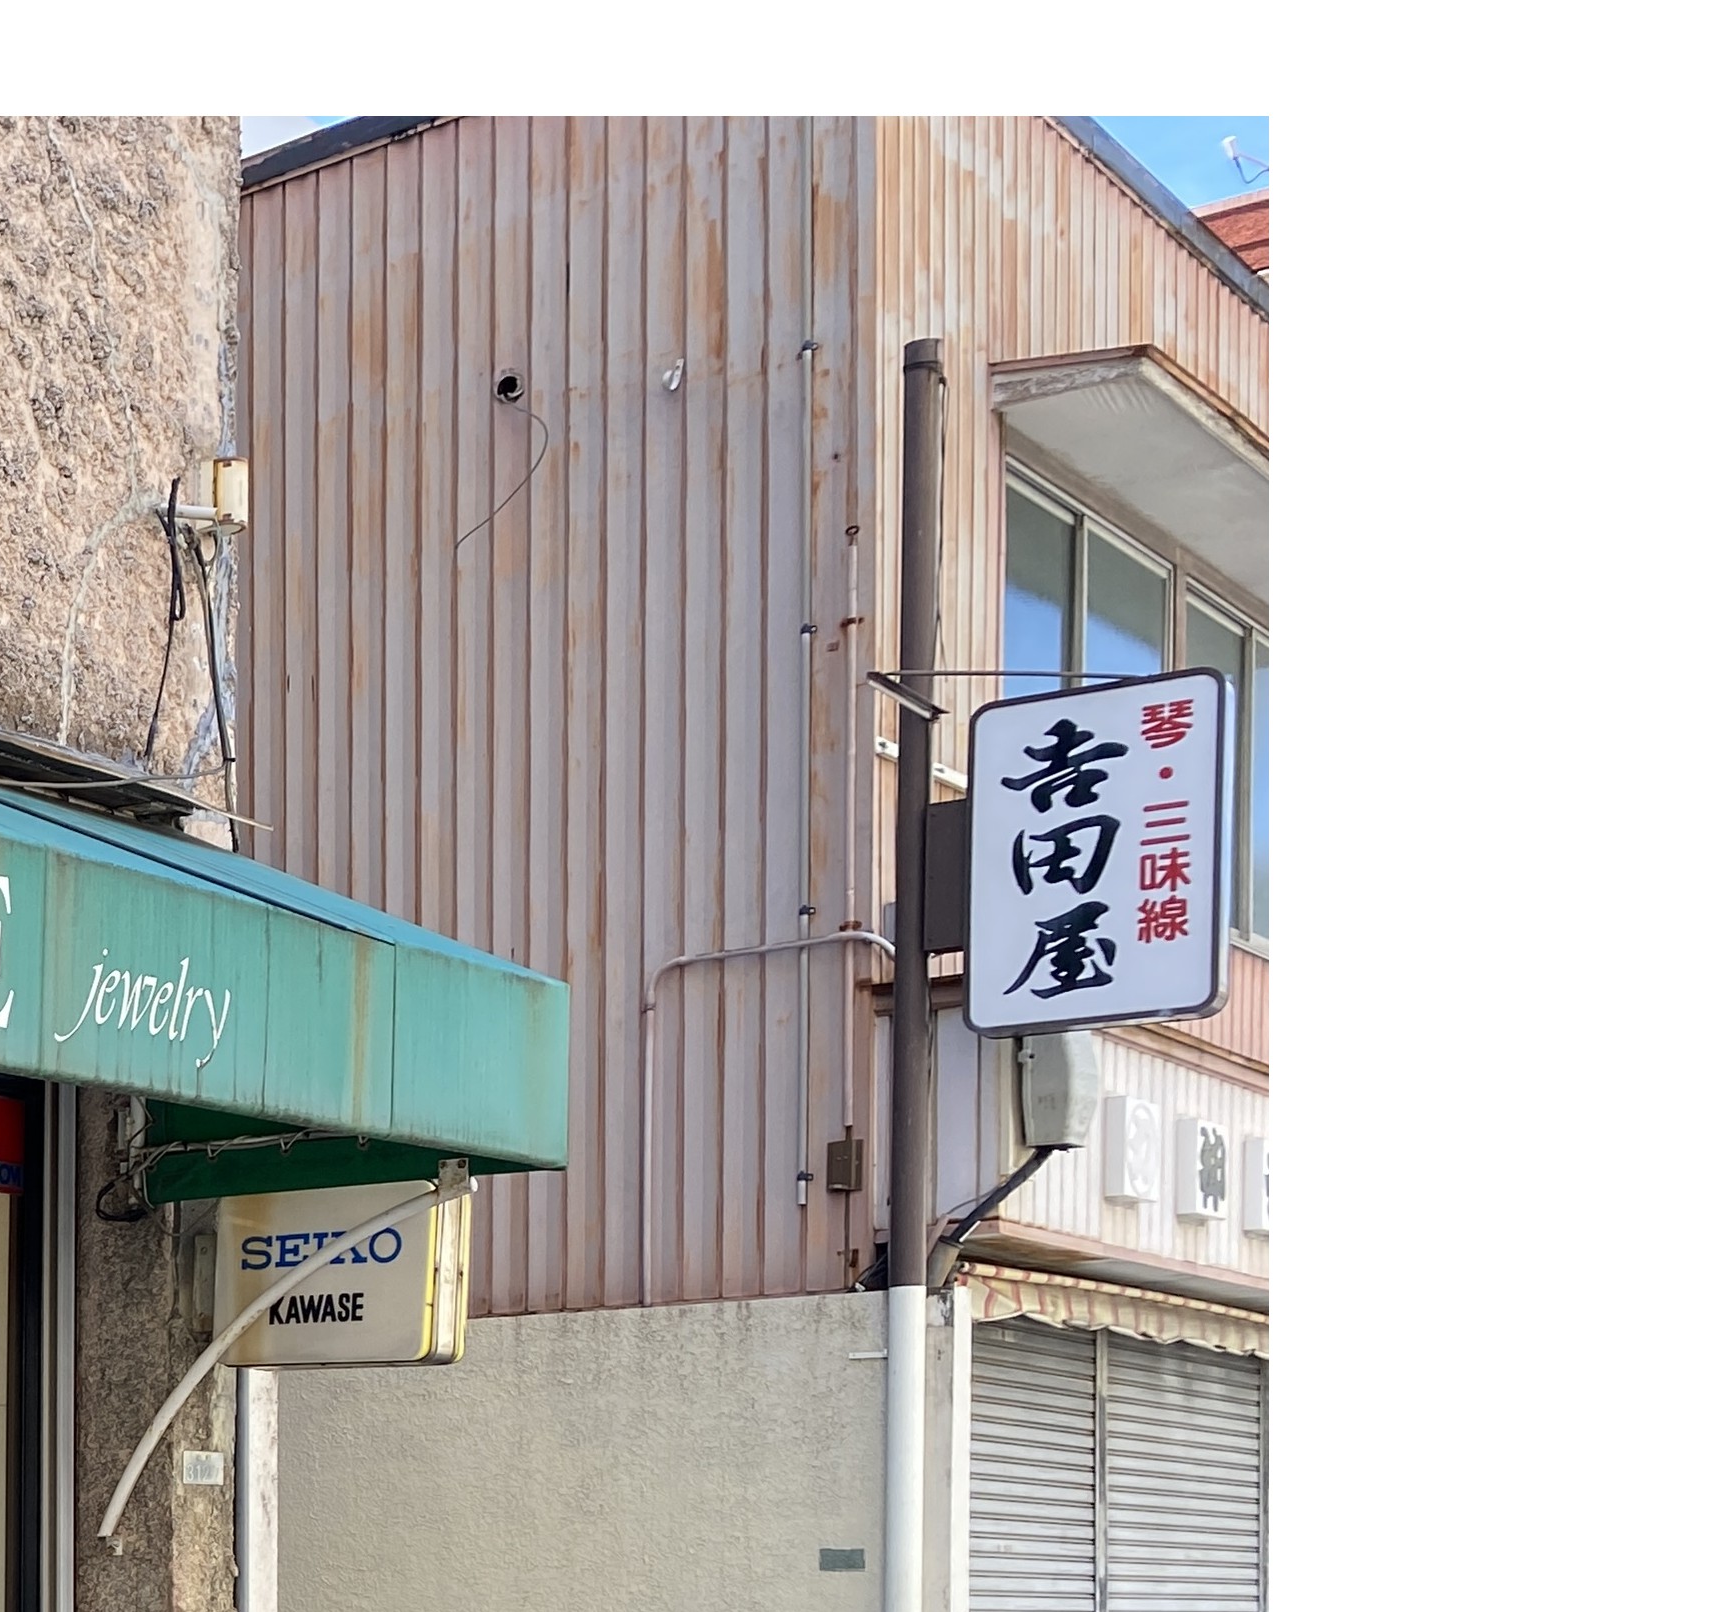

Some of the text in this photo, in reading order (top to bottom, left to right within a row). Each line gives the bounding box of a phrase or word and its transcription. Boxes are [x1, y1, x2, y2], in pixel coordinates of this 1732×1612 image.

[1137, 699, 1195, 944] 琴・三味線
[52, 946, 232, 1068] jewelry
[268, 1292, 364, 1326] KAWASE
